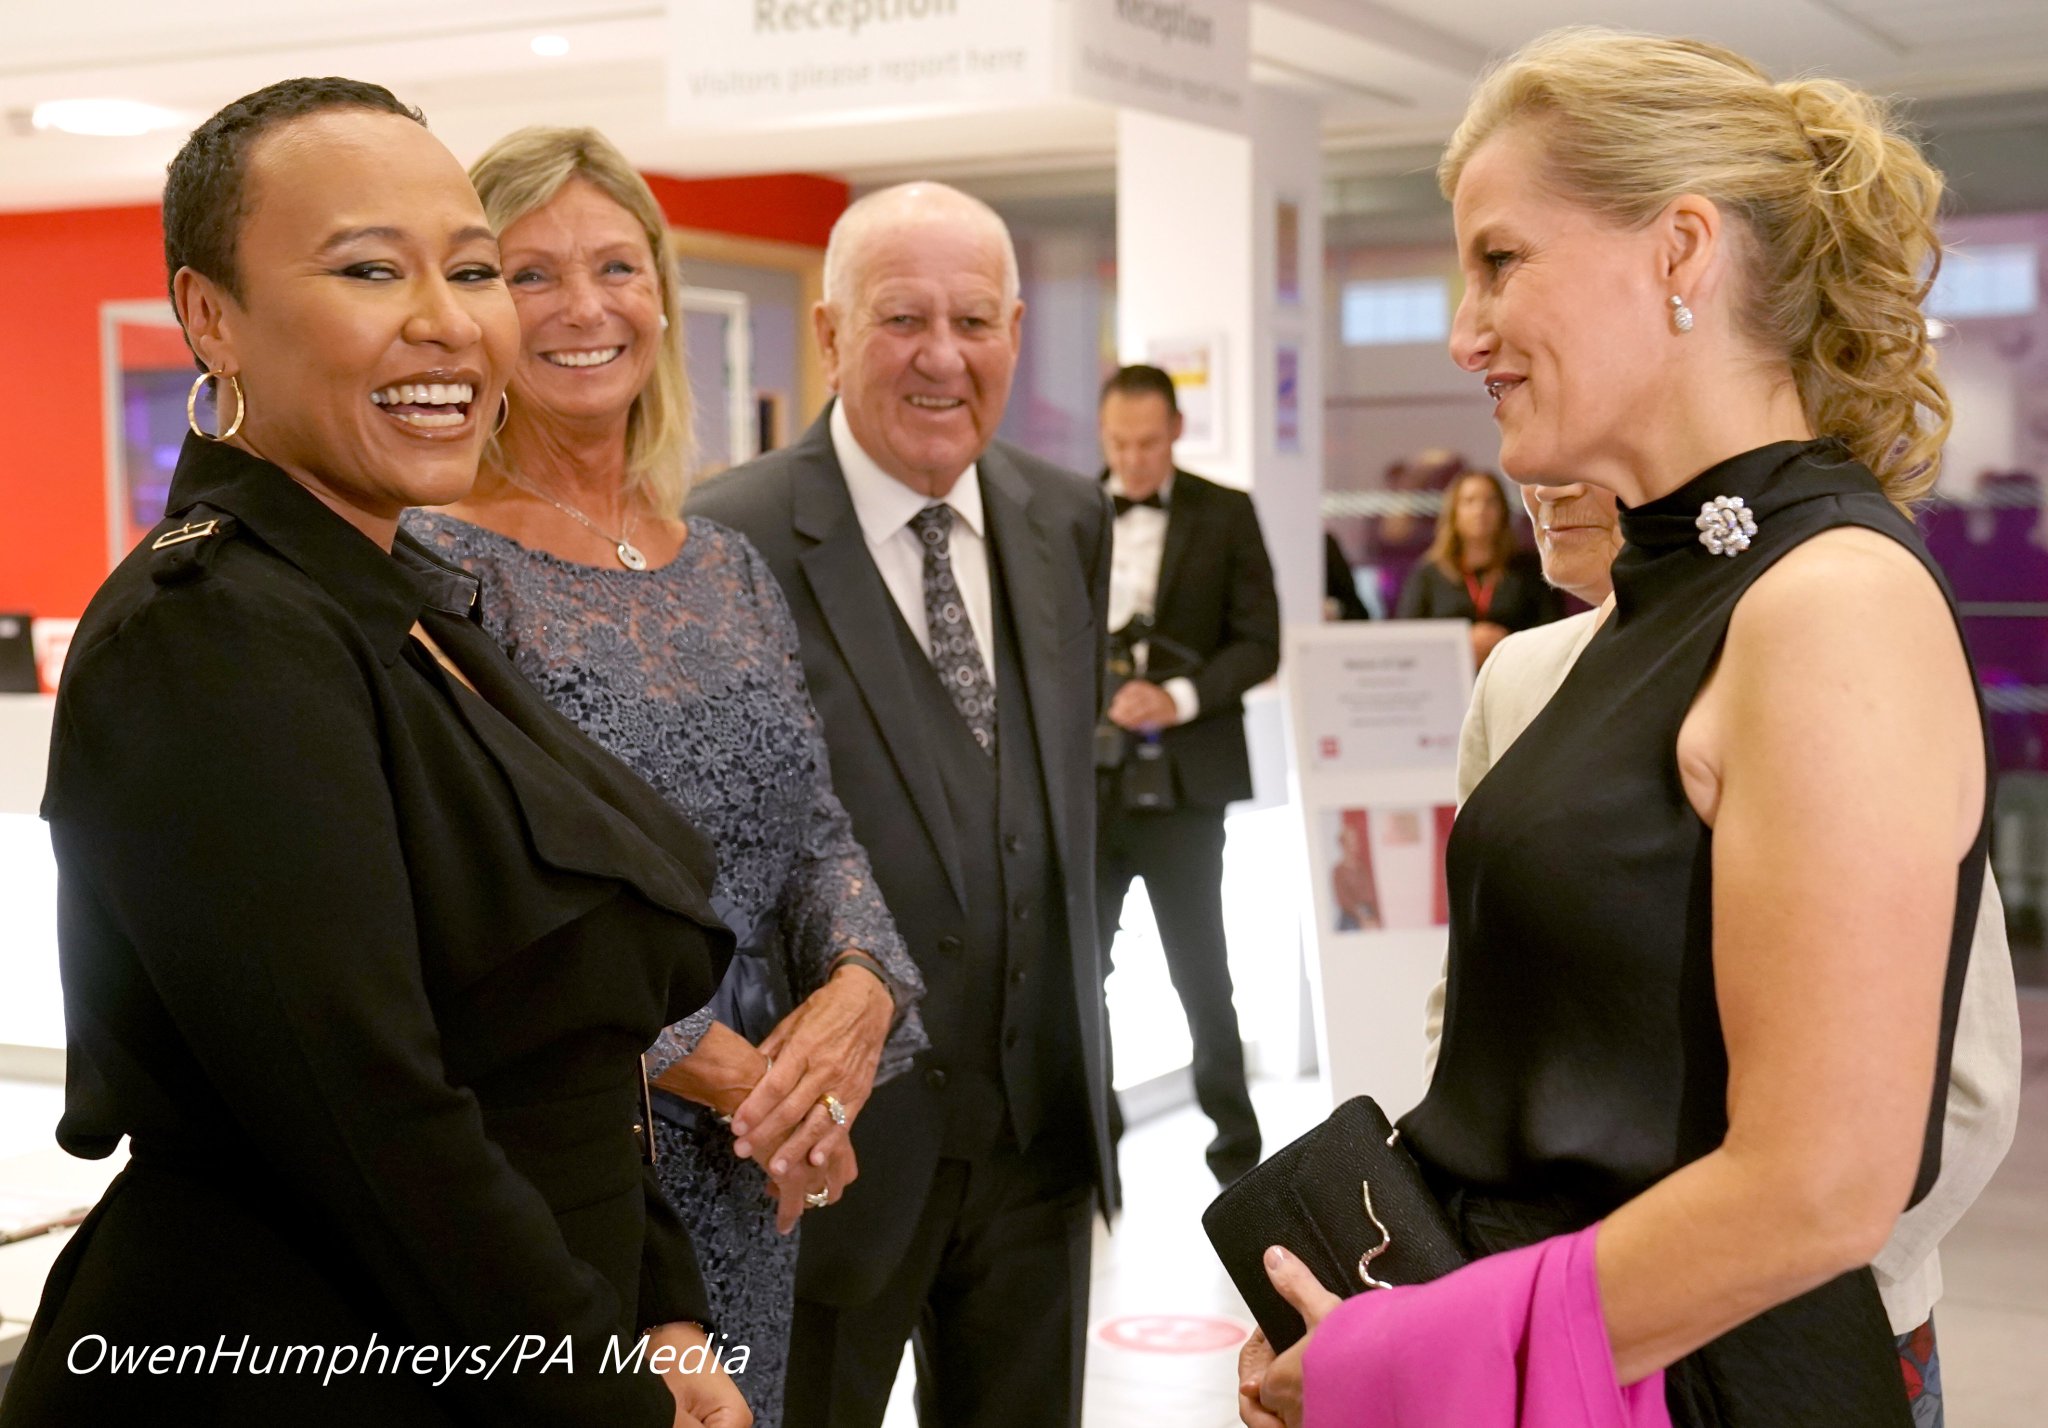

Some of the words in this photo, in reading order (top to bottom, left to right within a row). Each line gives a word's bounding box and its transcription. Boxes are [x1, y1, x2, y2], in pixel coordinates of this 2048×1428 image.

[787, 60, 872, 94] please
[879, 52, 960, 85] report
[965, 46, 1028, 72] here
